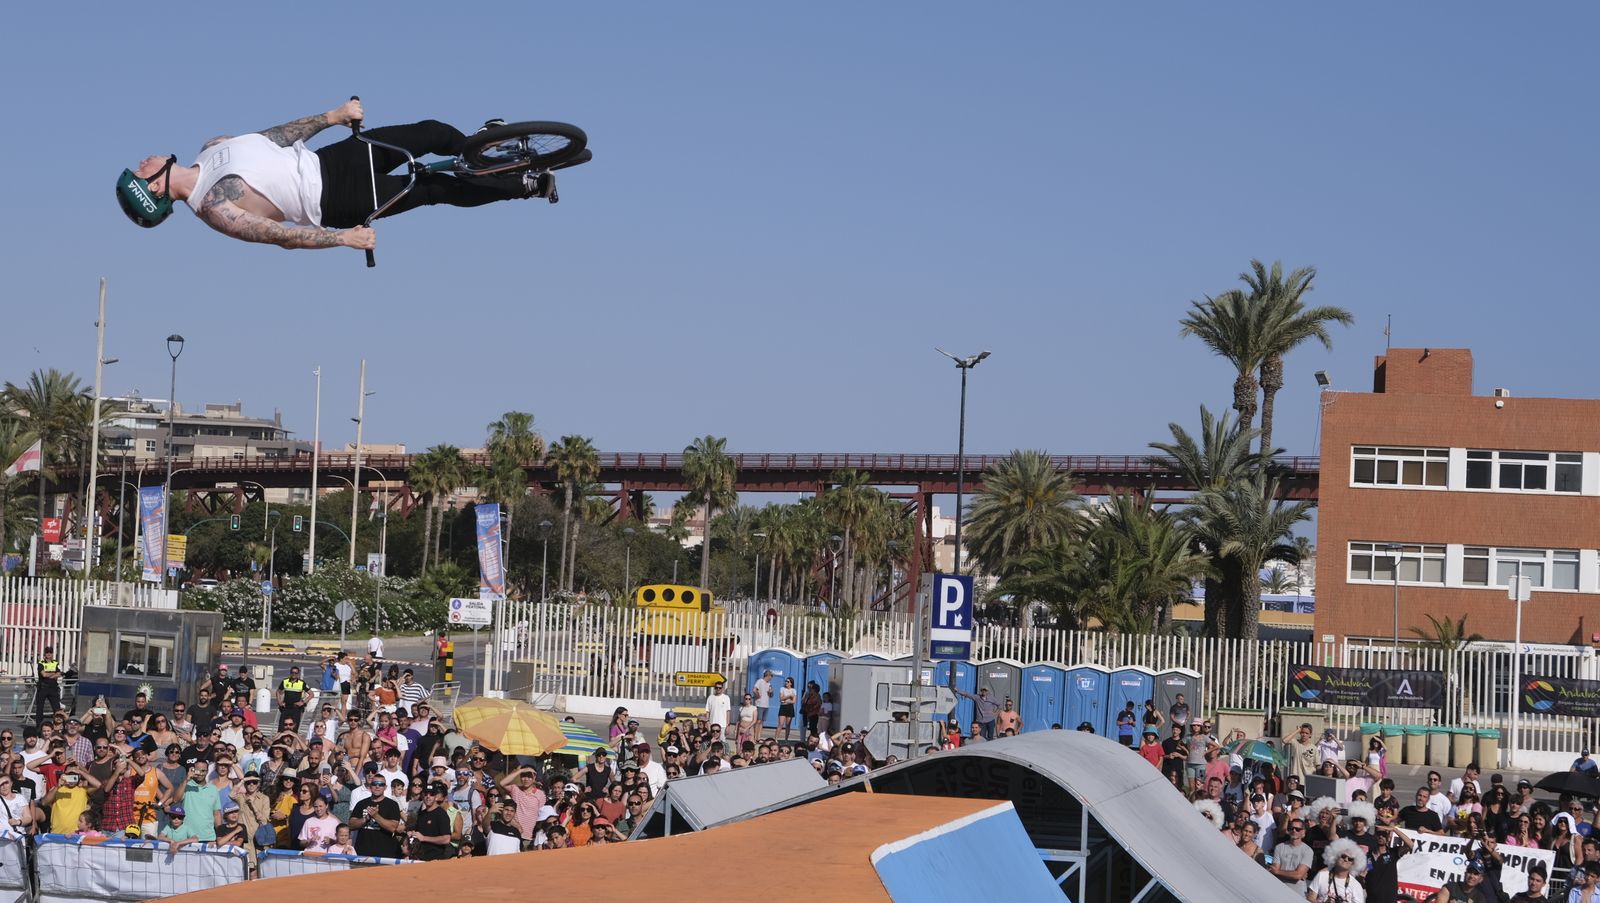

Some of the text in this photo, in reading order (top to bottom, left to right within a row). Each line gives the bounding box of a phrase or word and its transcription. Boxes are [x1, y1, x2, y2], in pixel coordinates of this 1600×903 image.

[128, 181, 154, 213] CANNA
[939, 578, 964, 625] P
[1430, 867, 1446, 881] EN
